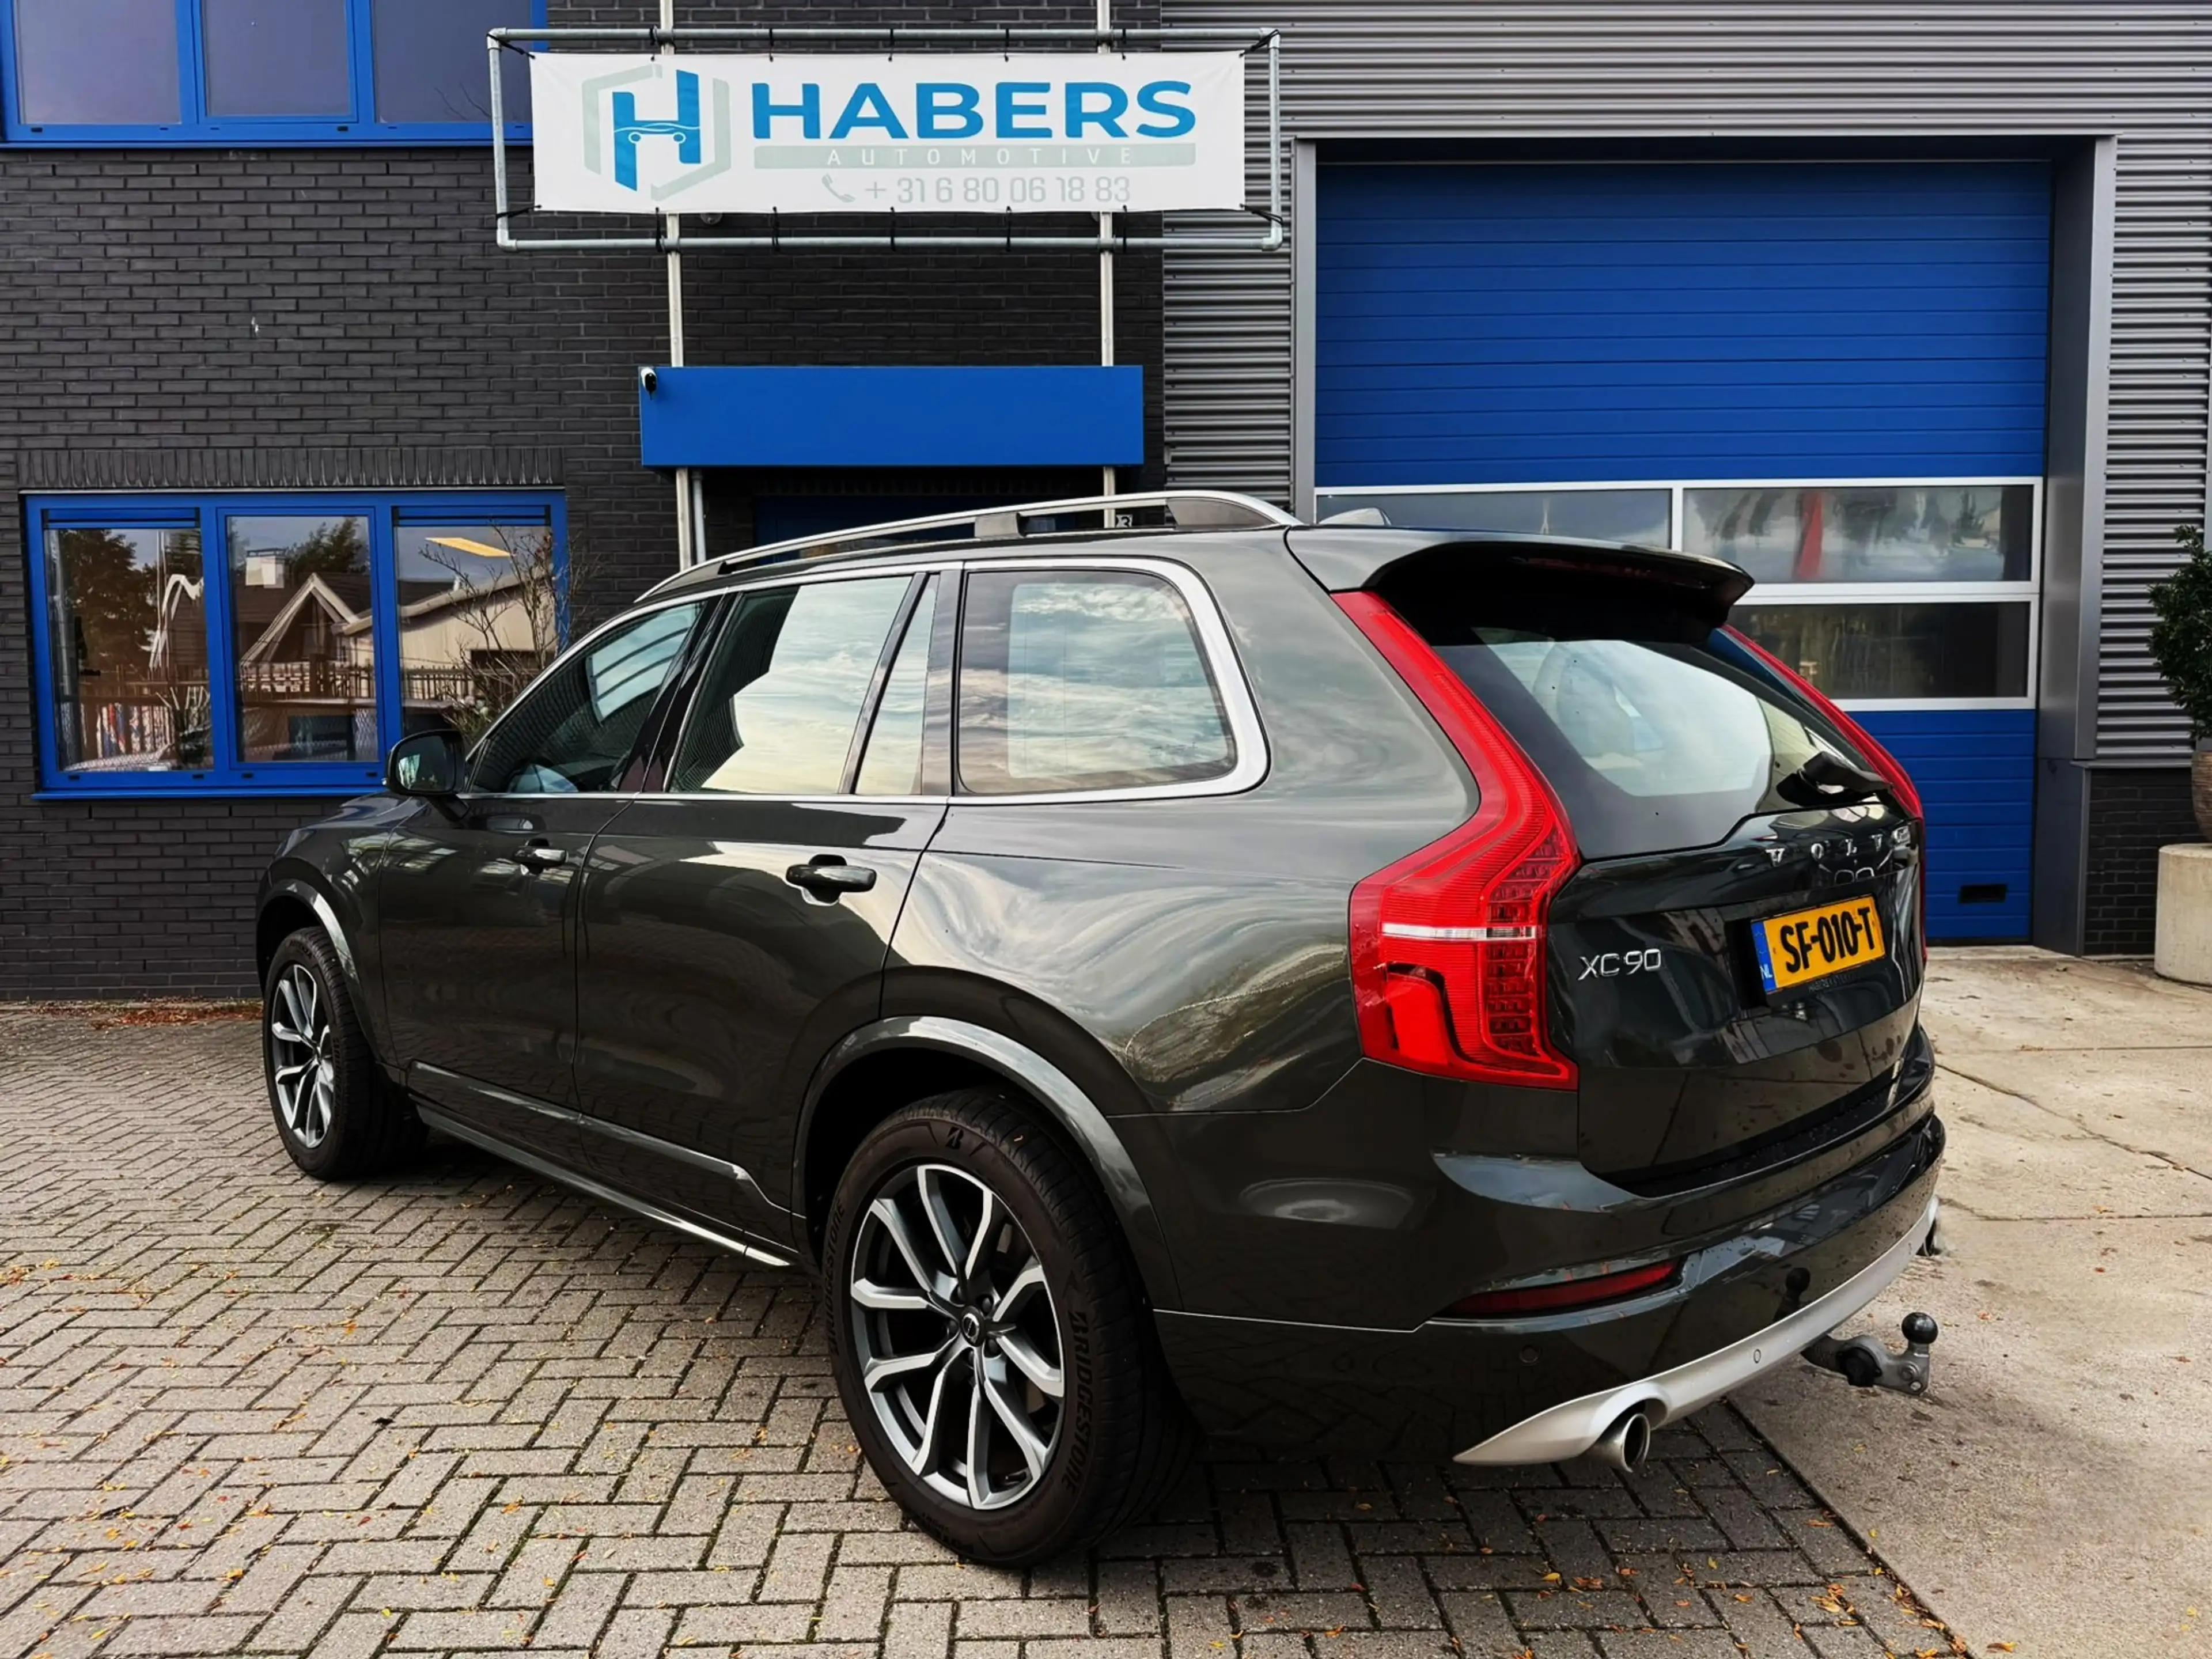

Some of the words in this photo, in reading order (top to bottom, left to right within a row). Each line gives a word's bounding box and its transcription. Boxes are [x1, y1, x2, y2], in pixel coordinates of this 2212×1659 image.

[751, 80, 1196, 141] HABERS
[827, 148, 1131, 165] AUTOMOTIVE
[935, 177, 953, 202] 6
[963, 177, 999, 202] 80
[1009, 177, 1046, 202] 06
[1055, 177, 1084, 202] 18
[1096, 176, 1130, 201] 83
[1765, 825, 1911, 866] VOLVO
[1780, 907, 1875, 974] SF-010-T
[1577, 948, 1661, 981] XC90
[1760, 964, 1773, 979] NL
[1062, 1309, 1093, 1494] BRIDGESTONE
